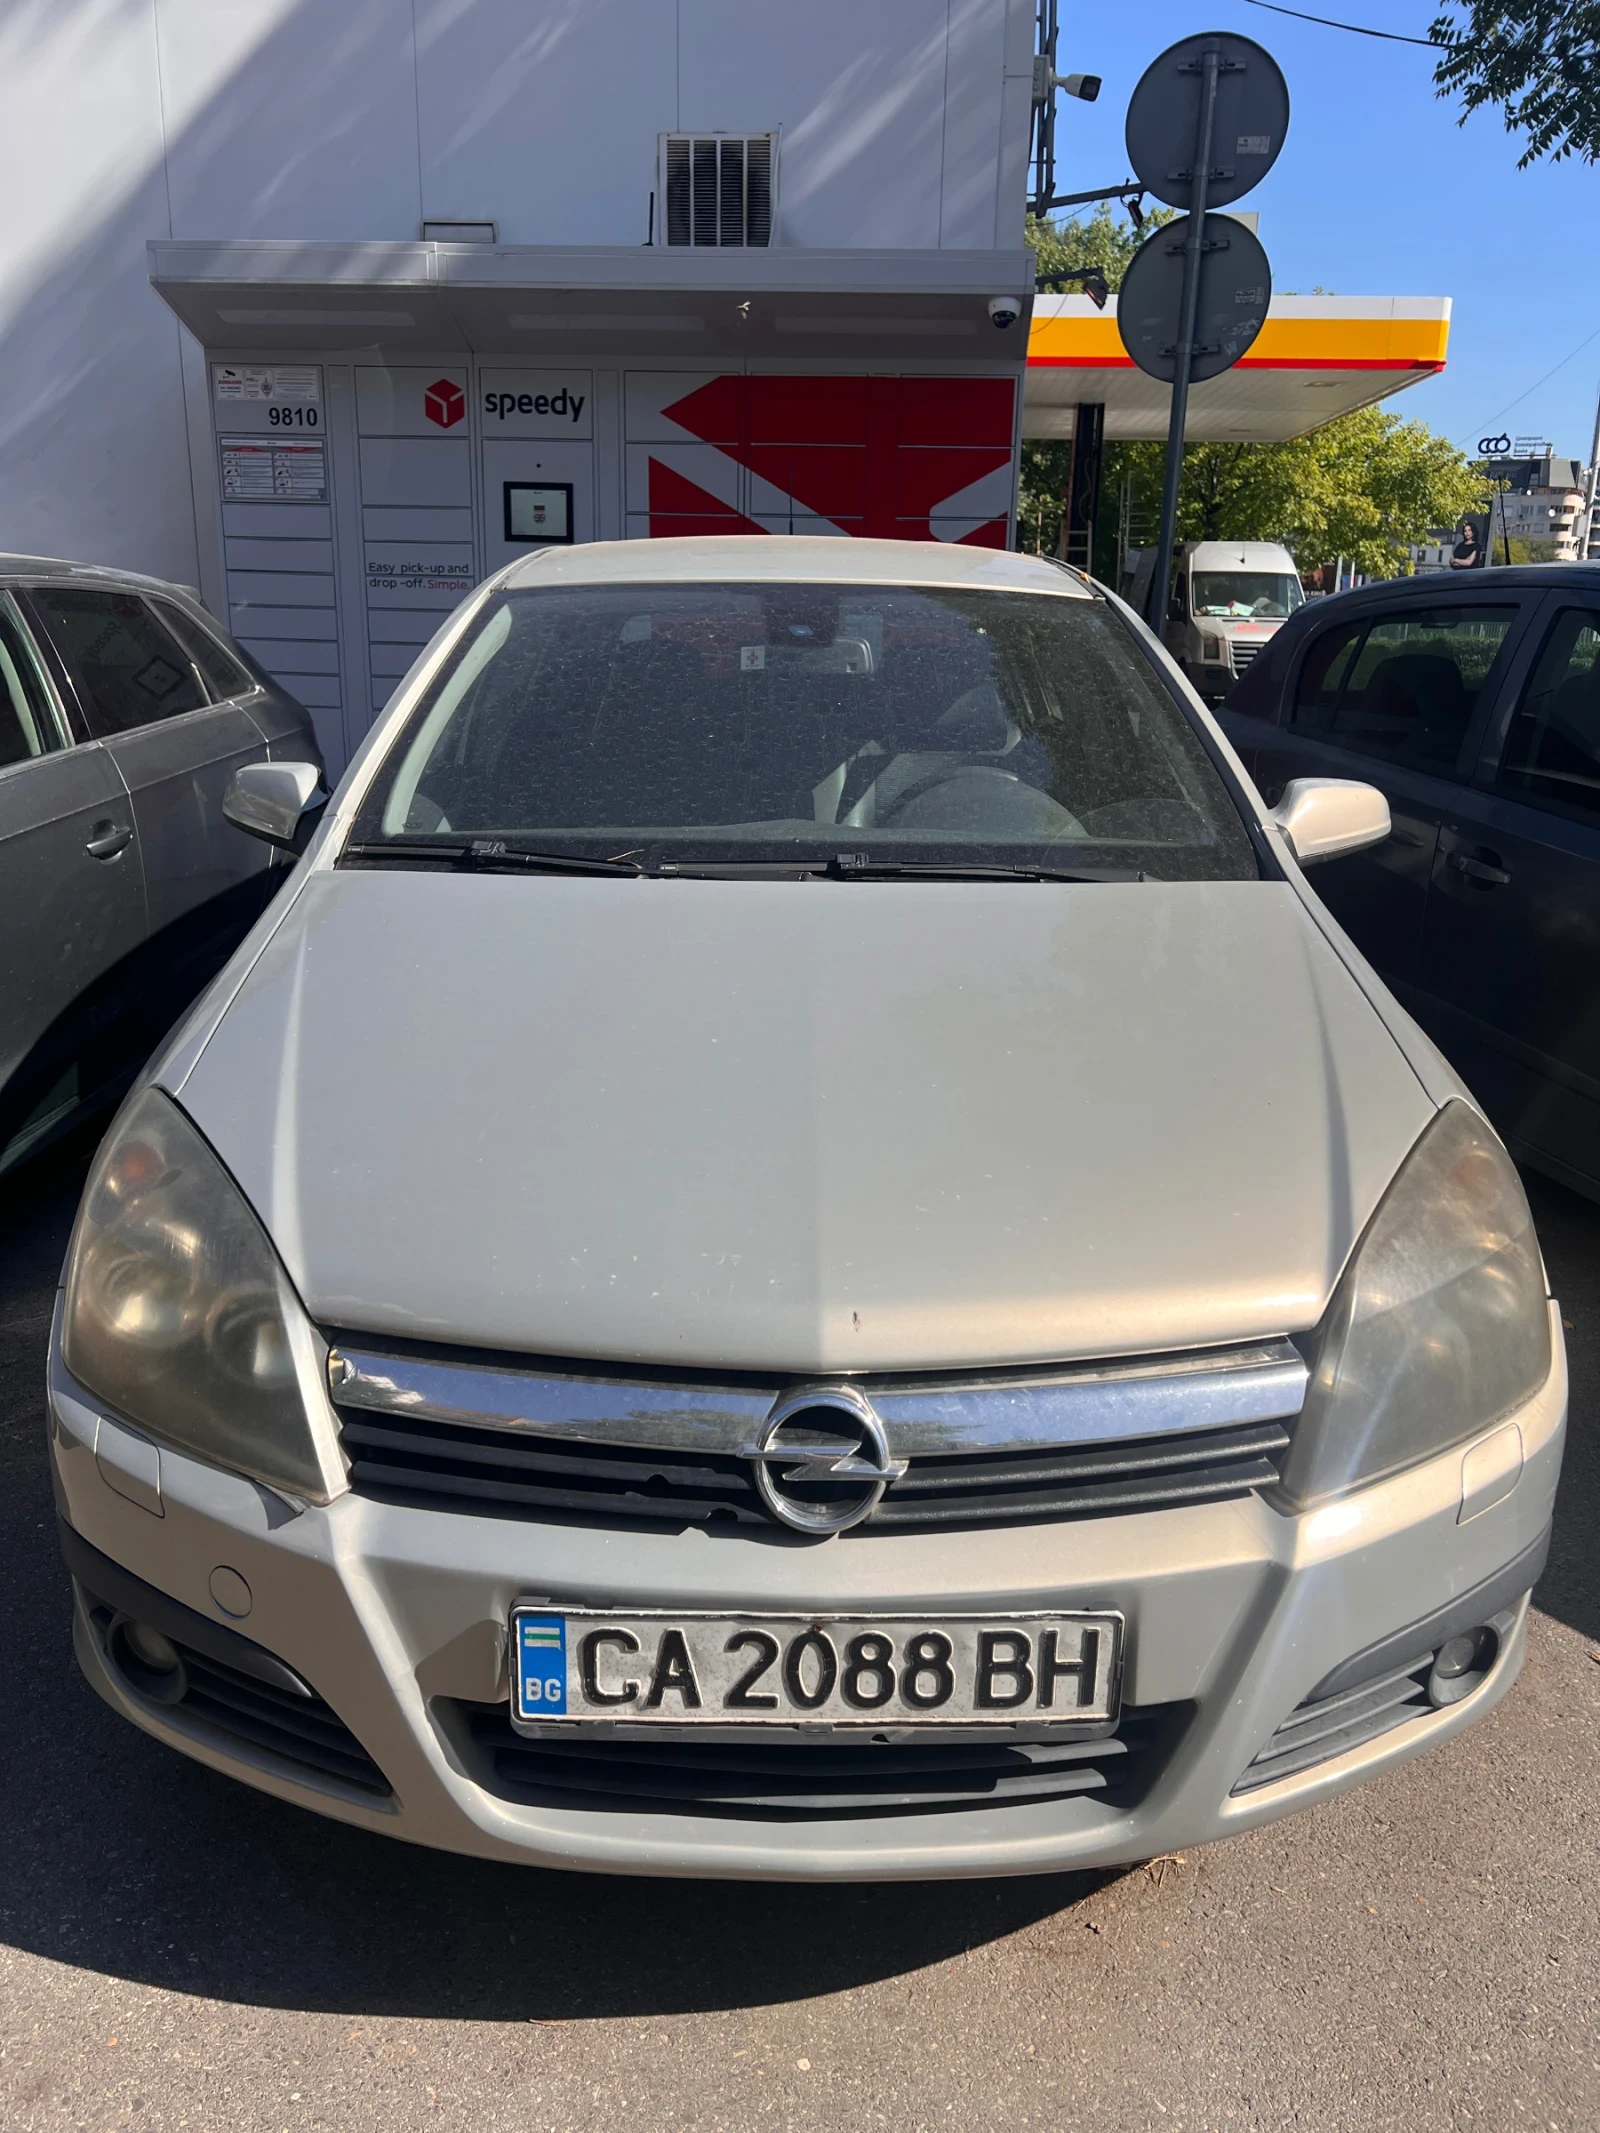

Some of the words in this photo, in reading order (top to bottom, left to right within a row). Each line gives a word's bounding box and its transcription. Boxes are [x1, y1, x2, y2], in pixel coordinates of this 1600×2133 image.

[268, 407, 318, 427] 9810
[485, 388, 586, 423] speedy
[368, 562, 396, 575] Easy
[400, 562, 445, 576] pick-up
[447, 563, 469, 574] and
[369, 577, 397, 589] drop
[427, 579, 470, 591] Simple.
[581, 1626, 704, 1710] CA
[722, 1628, 956, 1710] 2088
[976, 1627, 1102, 1709] BH
[524, 1677, 562, 1703] BG
